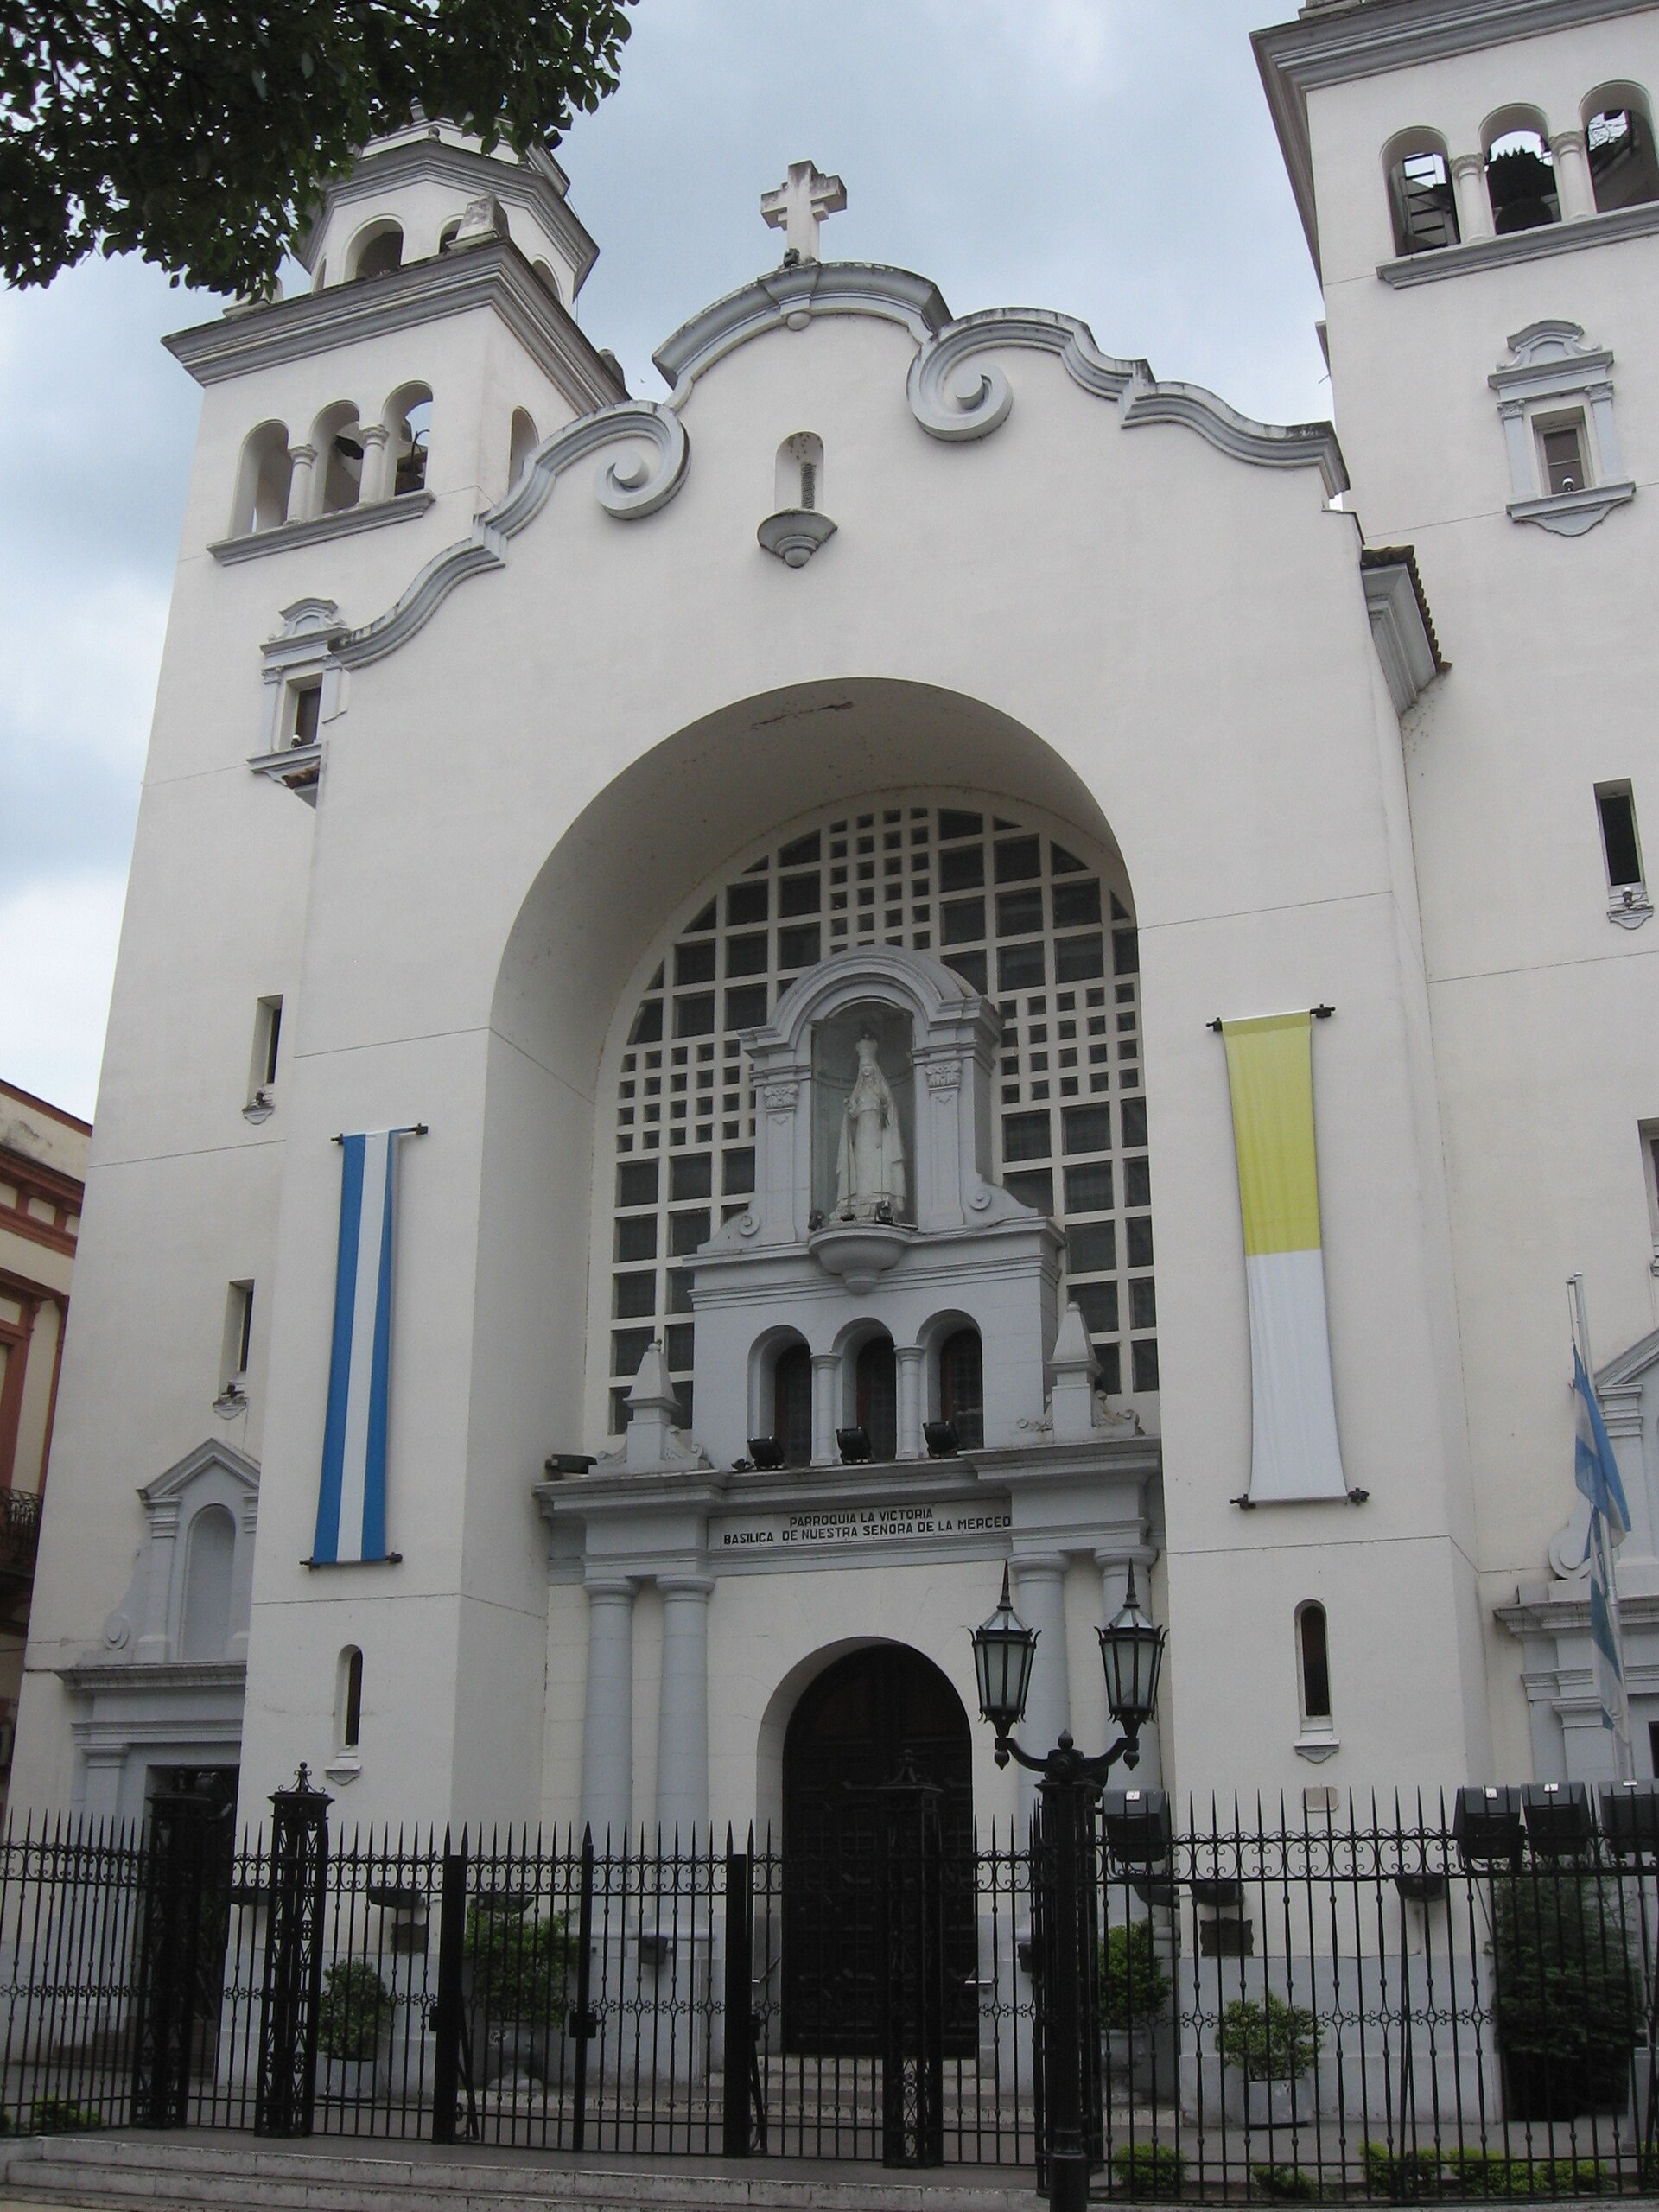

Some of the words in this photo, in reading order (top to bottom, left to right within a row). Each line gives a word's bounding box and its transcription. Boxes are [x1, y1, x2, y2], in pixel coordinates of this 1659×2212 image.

[724, 1532, 773, 1544] BASILICA
[782, 1530, 798, 1541] DE
[802, 1526, 857, 1540] NUESTRA
[918, 1522, 934, 1533] DE
[938, 1520, 953, 1531] LA
[957, 1516, 1011, 1529] MERCED
[790, 1513, 856, 1528] PARROQUIA
[861, 1512, 874, 1522] LA
[879, 1508, 933, 1521] VICTORIA
